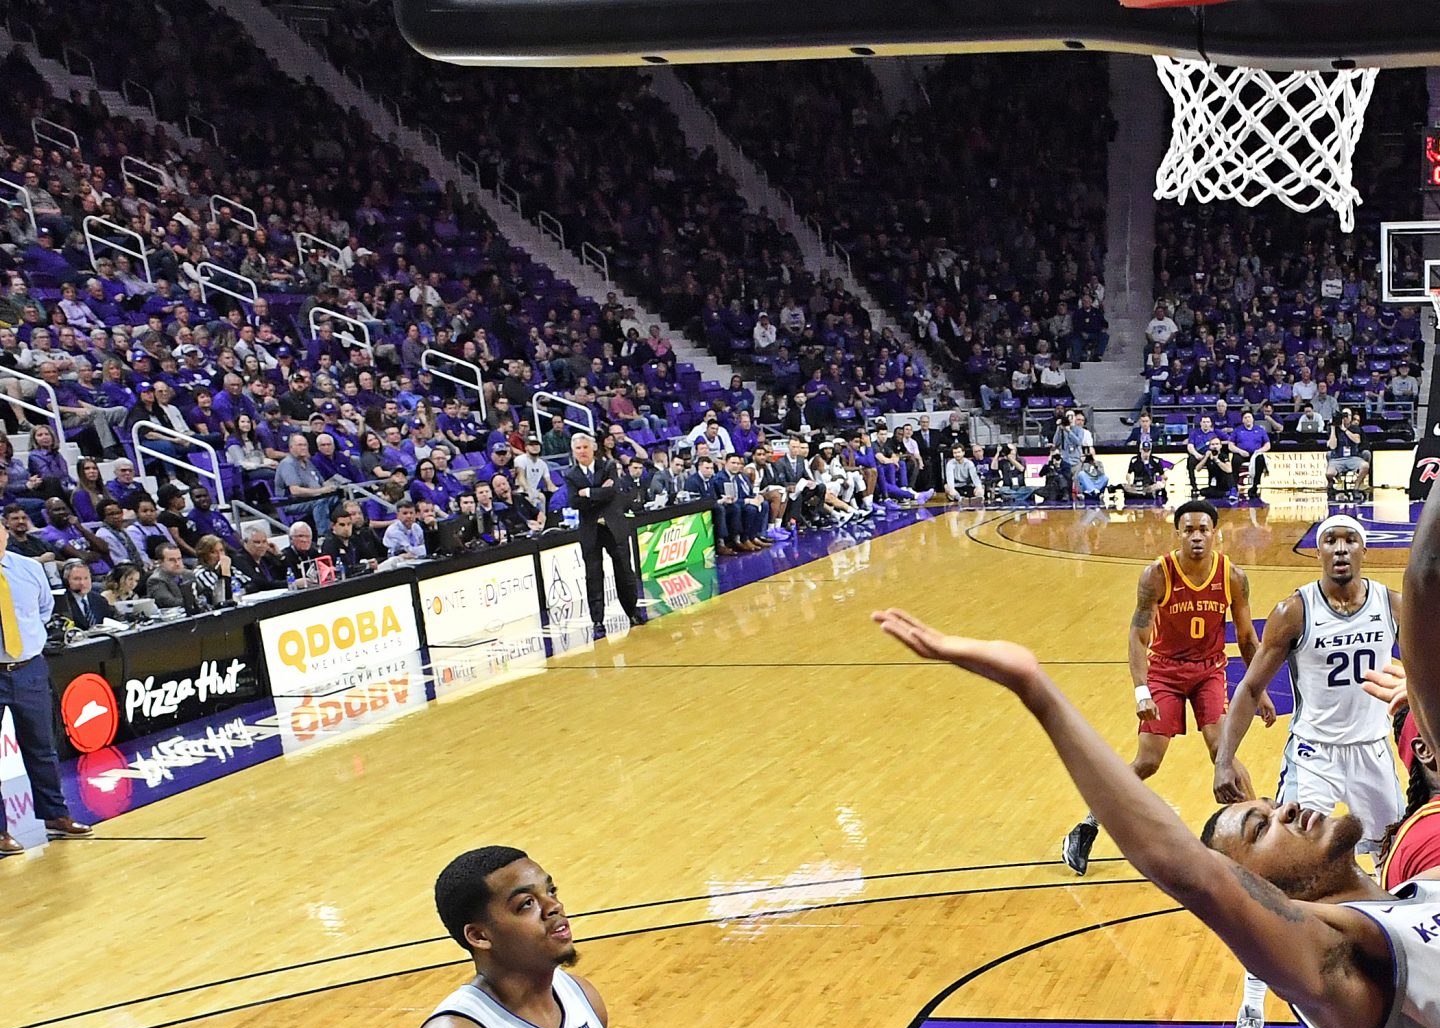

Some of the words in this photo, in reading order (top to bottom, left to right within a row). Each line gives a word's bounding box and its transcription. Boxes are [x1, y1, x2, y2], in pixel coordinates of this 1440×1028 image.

[1169, 600, 1194, 614] IOWA
[1197, 601, 1226, 614] STATE
[278, 605, 402, 673] QDOBA
[1190, 616, 1206, 639] 0
[1314, 631, 1385, 649] K-STATE
[1326, 649, 1376, 687] 20
[126, 669, 198, 722] Pizza
[194, 658, 247, 703] Hut
